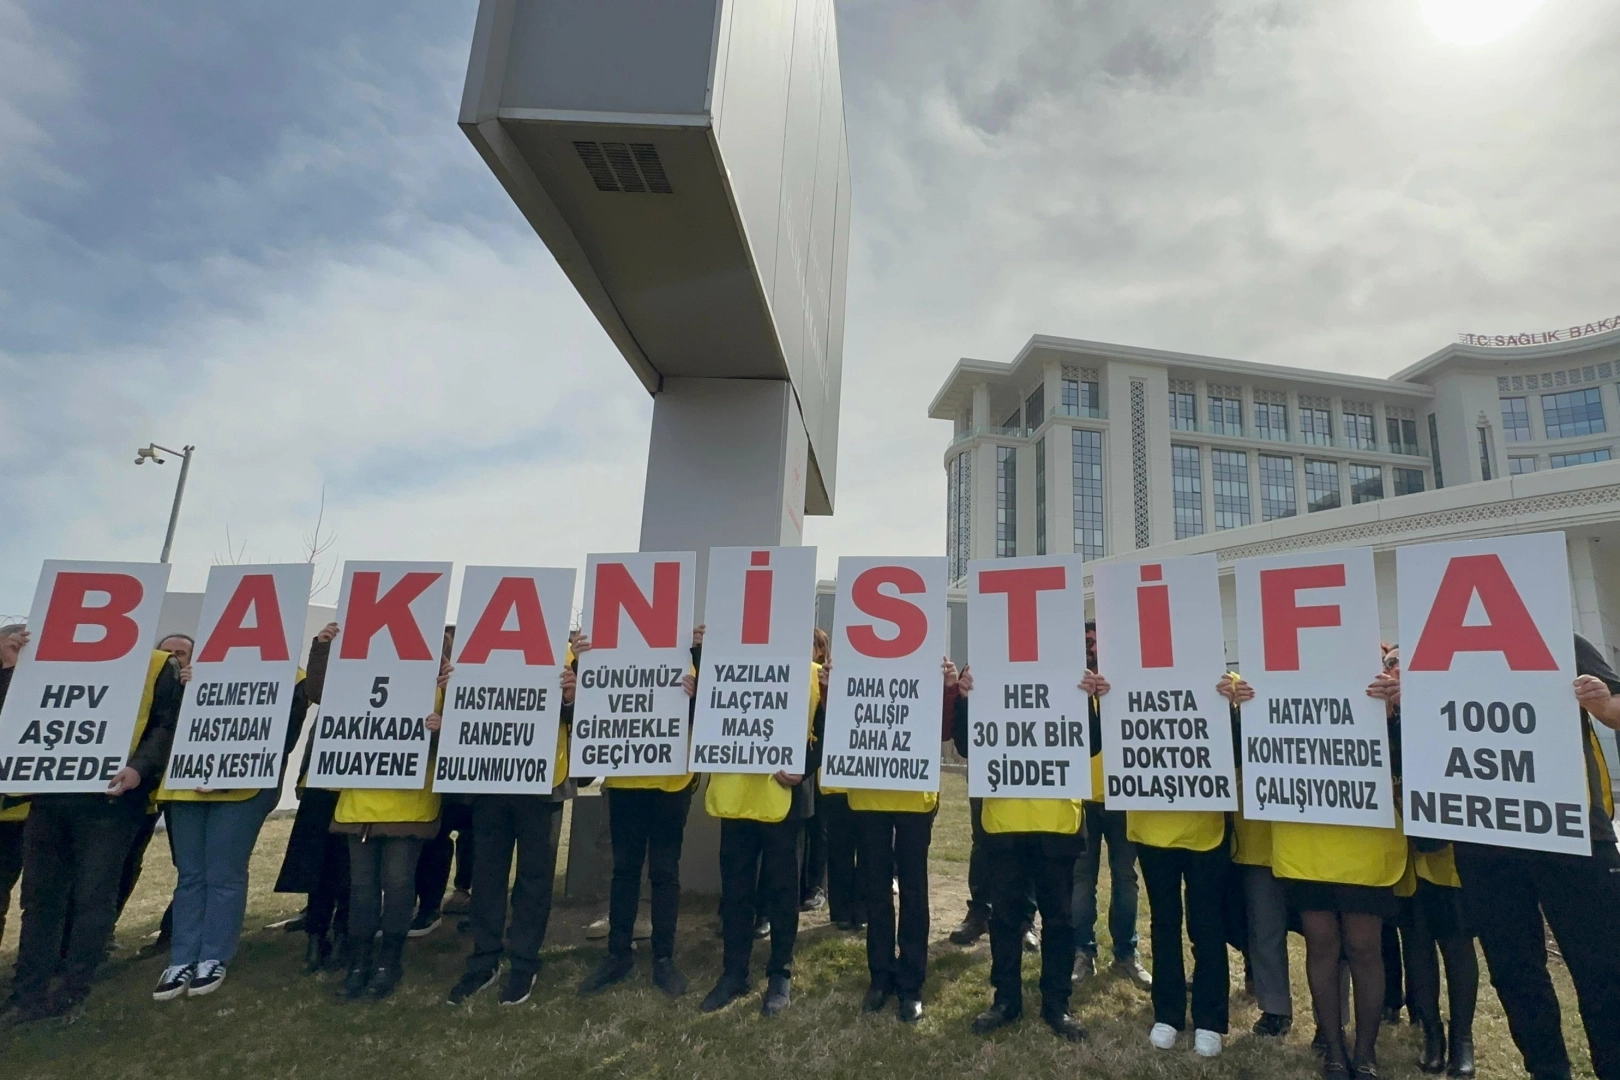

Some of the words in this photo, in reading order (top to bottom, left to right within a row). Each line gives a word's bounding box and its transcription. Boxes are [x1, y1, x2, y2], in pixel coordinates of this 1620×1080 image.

[1494, 329, 1560, 347] SAĞLIK
[1569, 315, 1620, 339] BAKA
[590, 562, 681, 649] N
[741, 551, 773, 644] İ
[35, 572, 144, 662] B
[197, 574, 290, 662] A
[340, 572, 444, 660] K
[456, 577, 556, 666] A
[846, 566, 928, 658] S
[979, 566, 1066, 662] T
[1137, 564, 1173, 668] İ
[1260, 564, 1346, 671] F
[1408, 553, 1560, 671] A
[581, 665, 683, 689] GÜNÜMÜZ
[715, 665, 789, 682] YAZILAN
[40, 685, 109, 708] HPV
[197, 682, 279, 706] GELMEYEN
[370, 677, 389, 708] 5
[455, 687, 547, 711] HASTANEDE
[608, 689, 653, 713] VERİ
[711, 687, 787, 713] İLAÇTAN
[848, 678, 884, 697] DAHA
[890, 679, 919, 703] ÇOK
[1005, 684, 1050, 708] HER
[1129, 690, 1197, 712] HASTA
[855, 703, 908, 729] ÇALIŞIP
[1268, 697, 1355, 725] HATAY'DA
[1441, 701, 1536, 734] 1000
[18, 720, 107, 750] AŞISI
[189, 717, 272, 741] HASTADAN
[320, 711, 425, 741] DAKİKADA
[459, 722, 534, 746] RANDEVU
[577, 715, 680, 739] GİRMEKLE
[722, 718, 773, 741] MAAŞ
[974, 722, 998, 746] 30
[1006, 722, 1037, 746] DK
[1045, 715, 1084, 746] BİR
[1121, 718, 1209, 740] DOKTOR
[582, 740, 671, 769] GEÇİYOR
[695, 741, 792, 765] KESİLİYOR
[850, 730, 887, 750] DAHA
[892, 731, 911, 751] AZ
[1248, 737, 1382, 767] KONTEYNERDE
[170, 754, 214, 784] MAAŞ
[217, 747, 277, 777] KESTİK
[317, 751, 418, 776] MUAYENE
[437, 757, 547, 782] BULUNMUYOR
[827, 755, 929, 779] KAZANIYORUZ
[1123, 747, 1211, 768] DOKTOR
[1445, 747, 1535, 783] ASM
[988, 754, 1069, 792] ŞİDDET
[1108, 775, 1230, 803] DOLAŞIYOR
[1256, 777, 1378, 813] ÇALIŞIYORUZ
[1410, 790, 1585, 839] NEREDE
